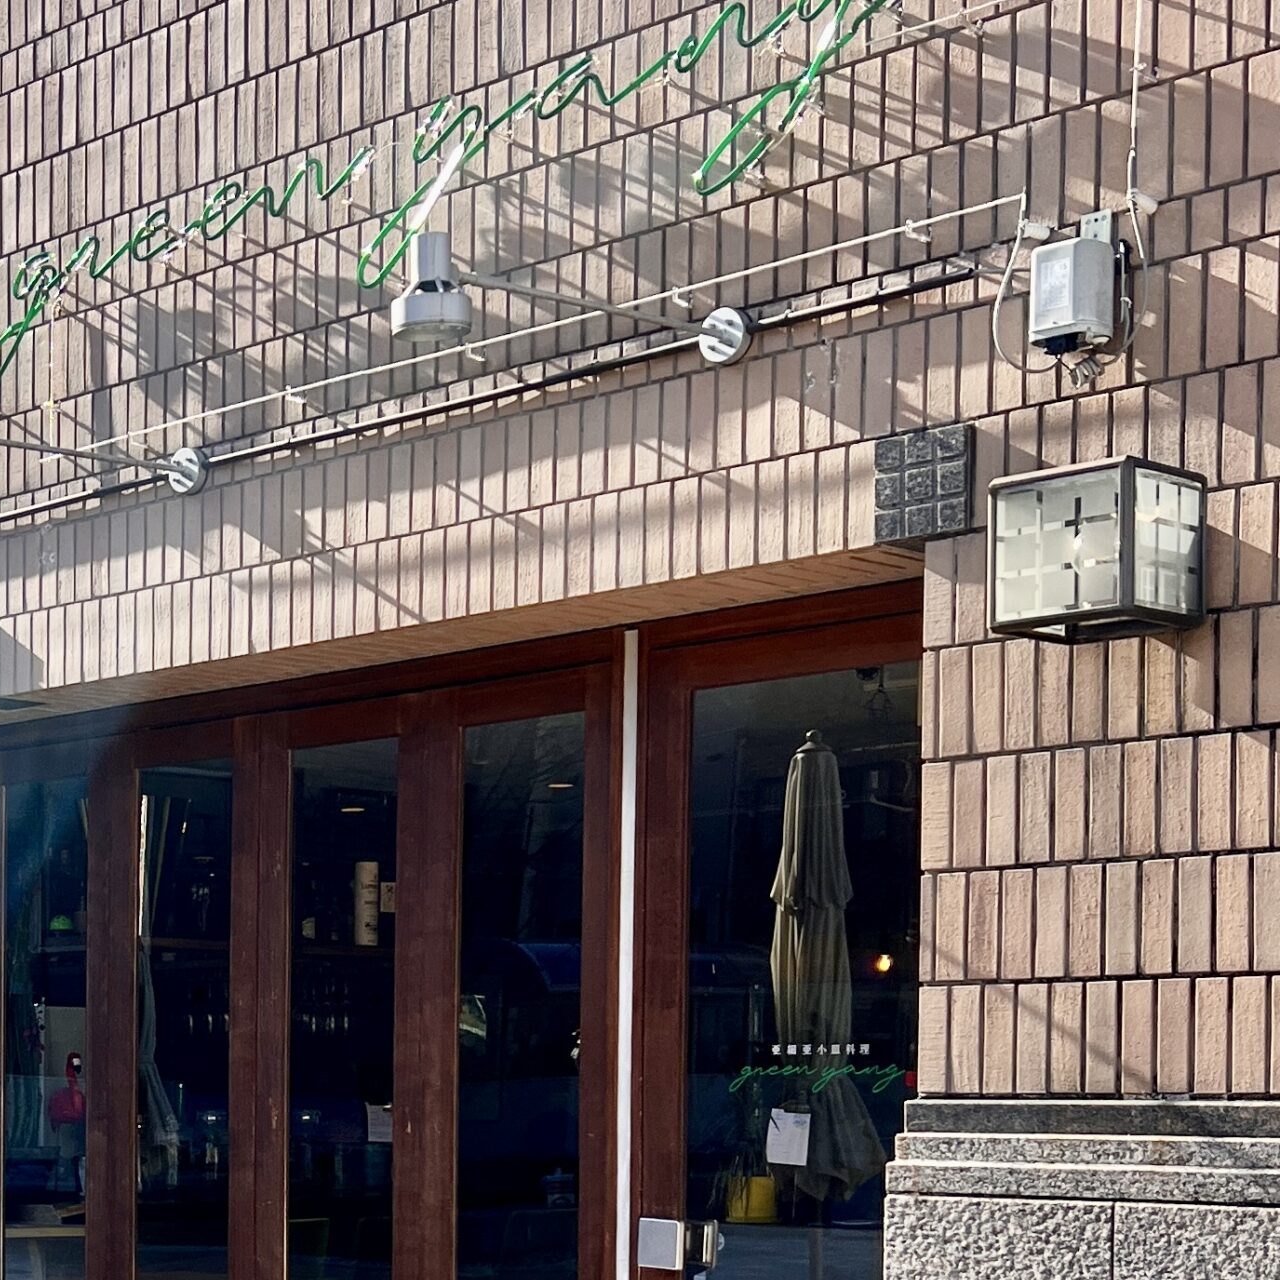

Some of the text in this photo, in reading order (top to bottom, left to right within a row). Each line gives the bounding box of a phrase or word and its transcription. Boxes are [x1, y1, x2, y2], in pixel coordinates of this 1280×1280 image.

[358, 0, 902, 290] yang
[728, 1063, 906, 1094] green yang
